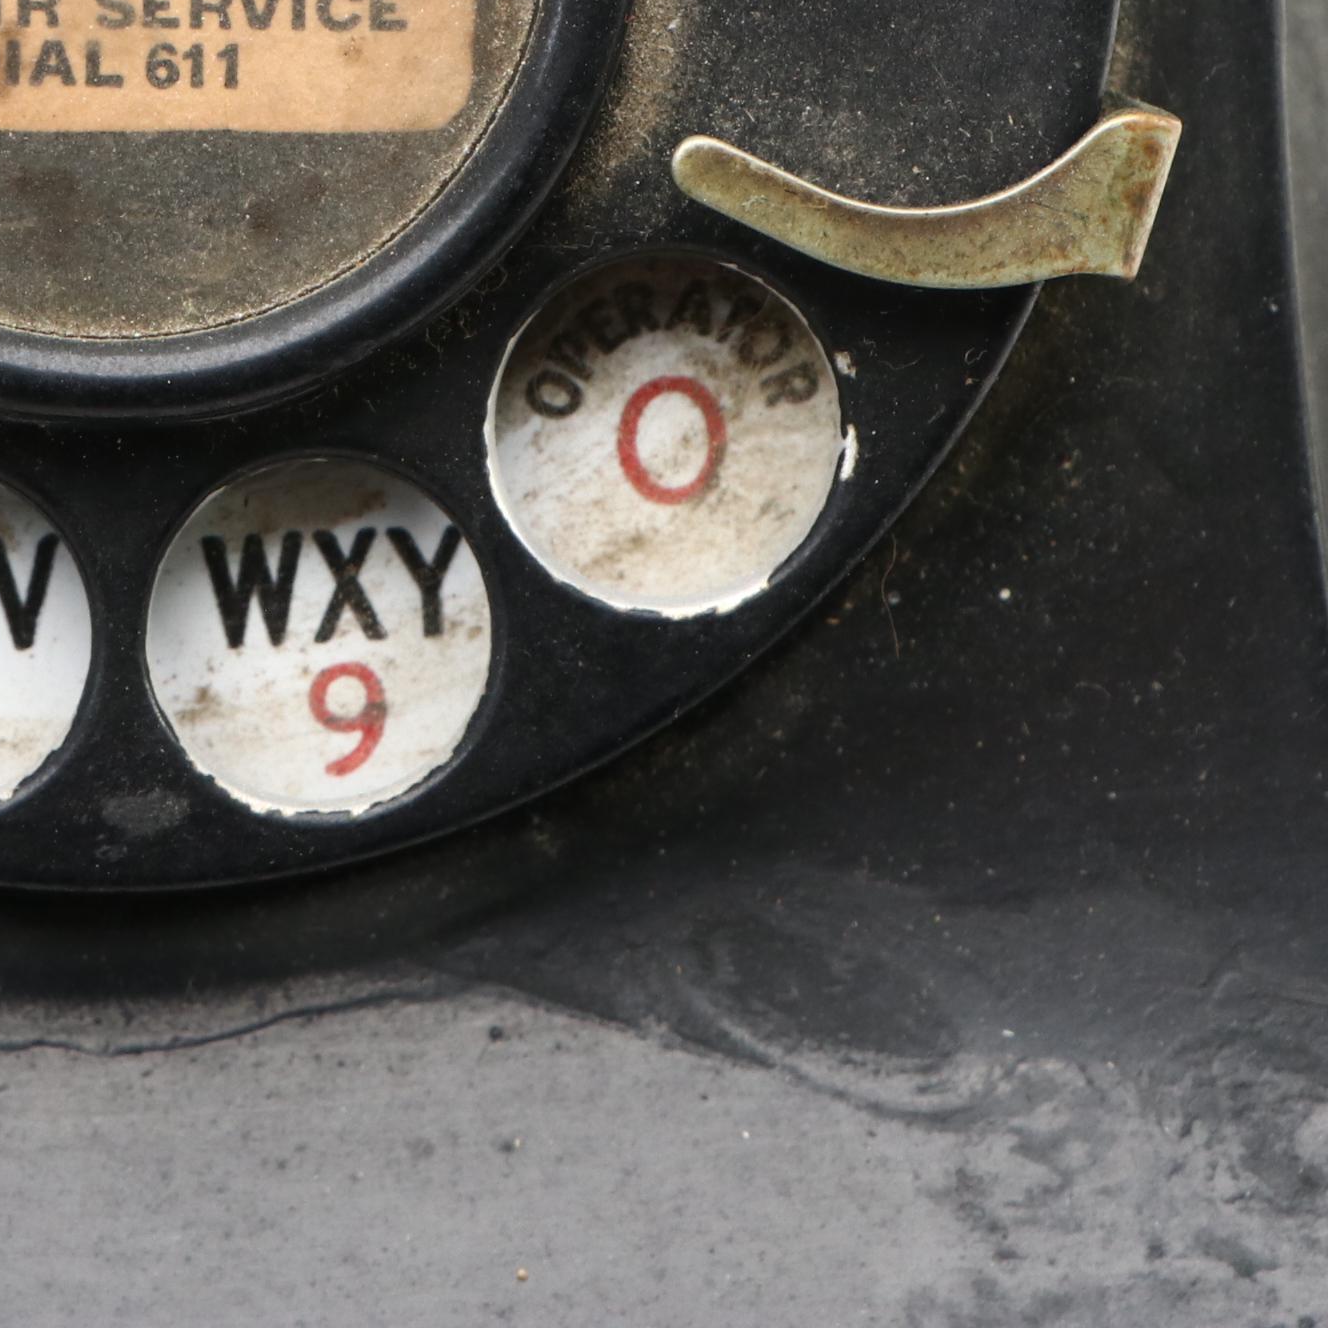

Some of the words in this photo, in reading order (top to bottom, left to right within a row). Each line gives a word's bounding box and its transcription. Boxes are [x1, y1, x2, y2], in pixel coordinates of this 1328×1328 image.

[145, 42, 243, 90] 611
[199, 524, 463, 650] WXY
[307, 660, 389, 778] 9
